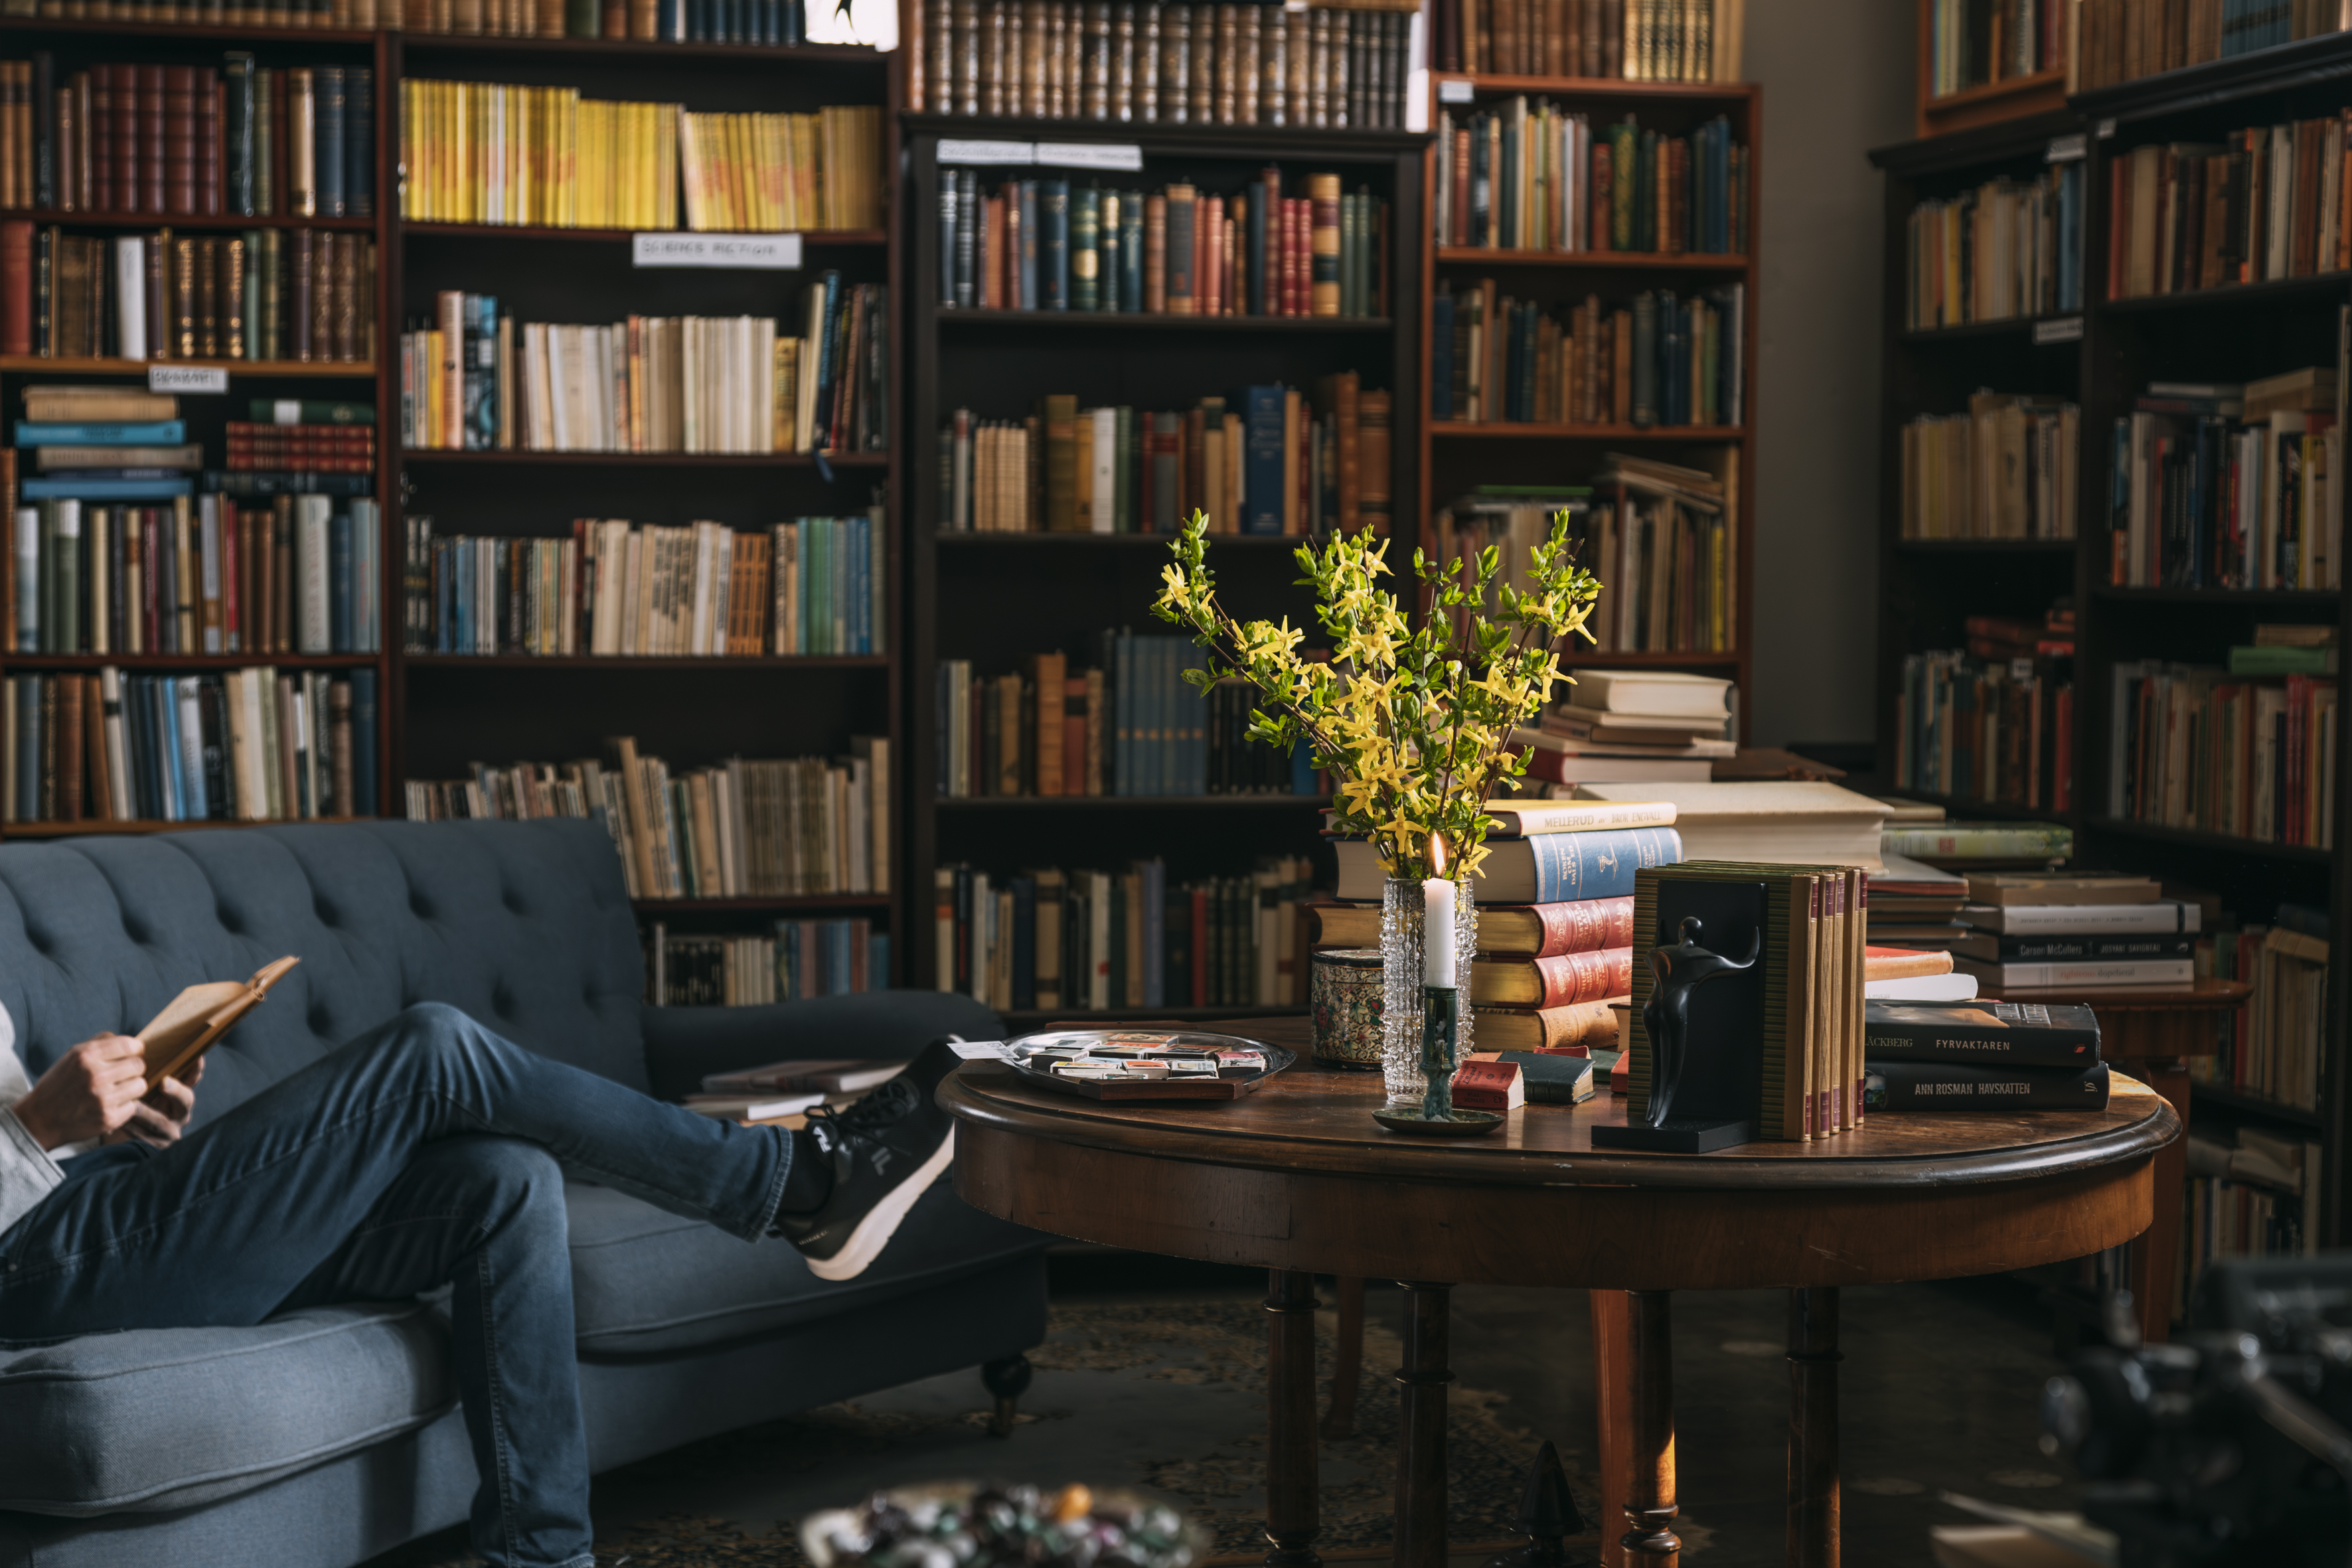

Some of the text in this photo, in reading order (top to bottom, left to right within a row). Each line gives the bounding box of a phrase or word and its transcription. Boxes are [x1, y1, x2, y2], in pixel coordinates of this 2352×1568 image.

[1545, 815, 1595, 828] MELLERUD
[1612, 813, 1628, 823] BROR
[1632, 811, 1662, 822] ENGVALL
[1566, 856, 1572, 874] OM
[2021, 944, 2082, 956] Carson McCullers
[2061, 968, 2135, 980] righteous dopefiend
[1936, 1039, 2010, 1050] FYRVAKTAREN
[1915, 1083, 2030, 1095] ANN ROSMAN HAVSKATTEN
